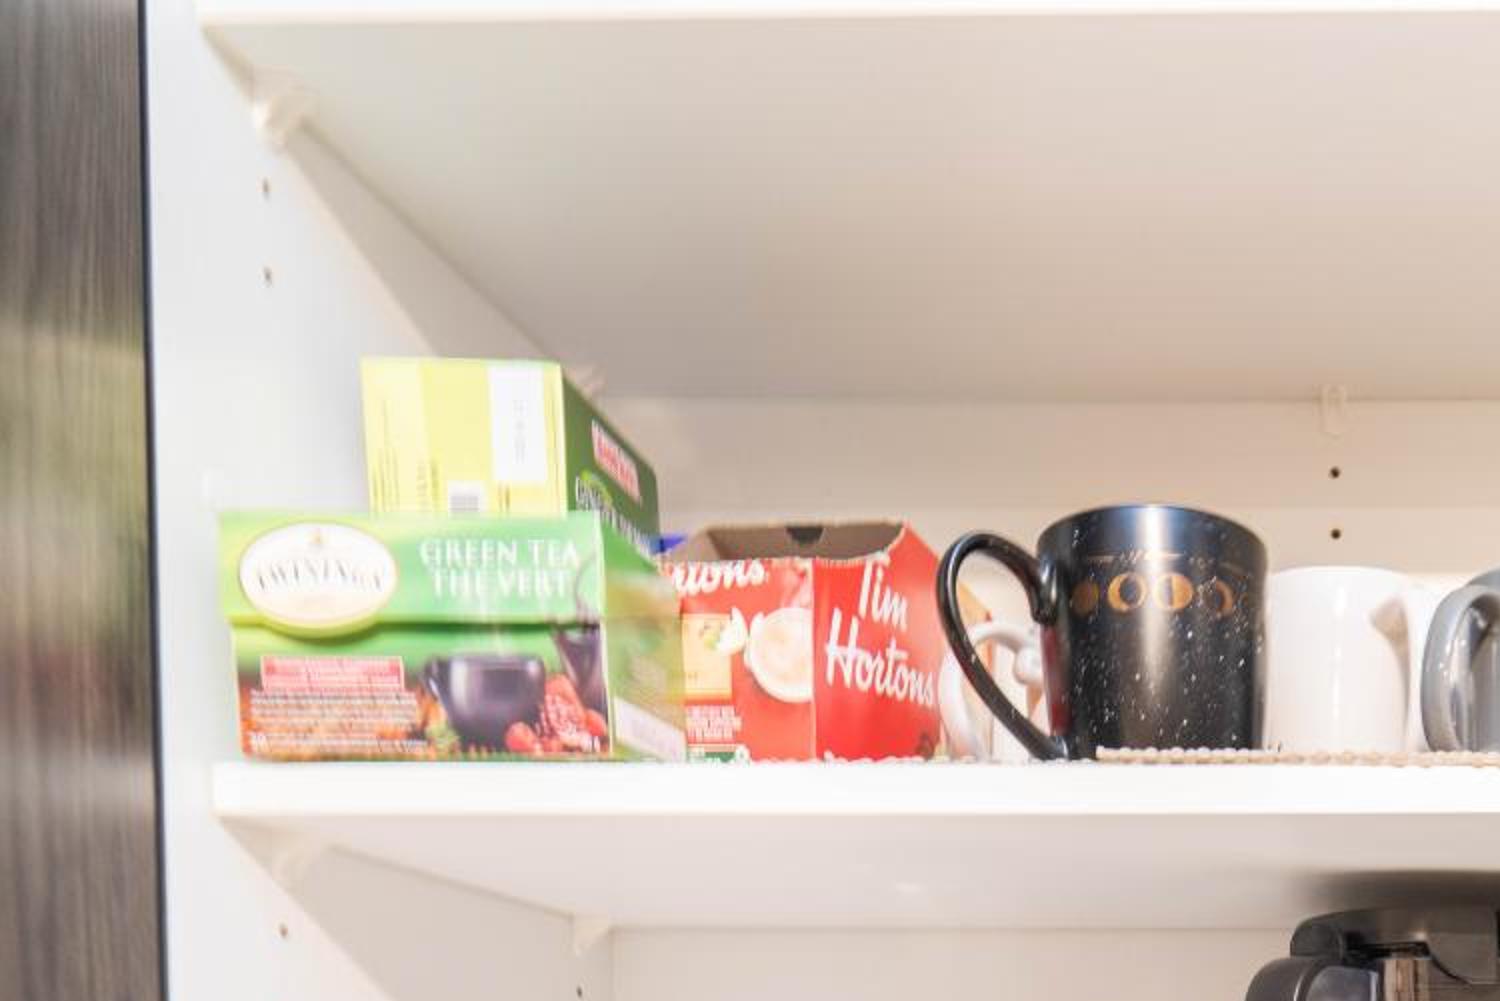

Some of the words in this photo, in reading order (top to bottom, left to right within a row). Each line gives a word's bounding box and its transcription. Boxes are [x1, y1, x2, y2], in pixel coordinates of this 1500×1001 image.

[420, 537, 518, 568] GREEN
[527, 538, 581, 568] TEA
[858, 550, 908, 633] Tim
[824, 605, 936, 707] Hortons
